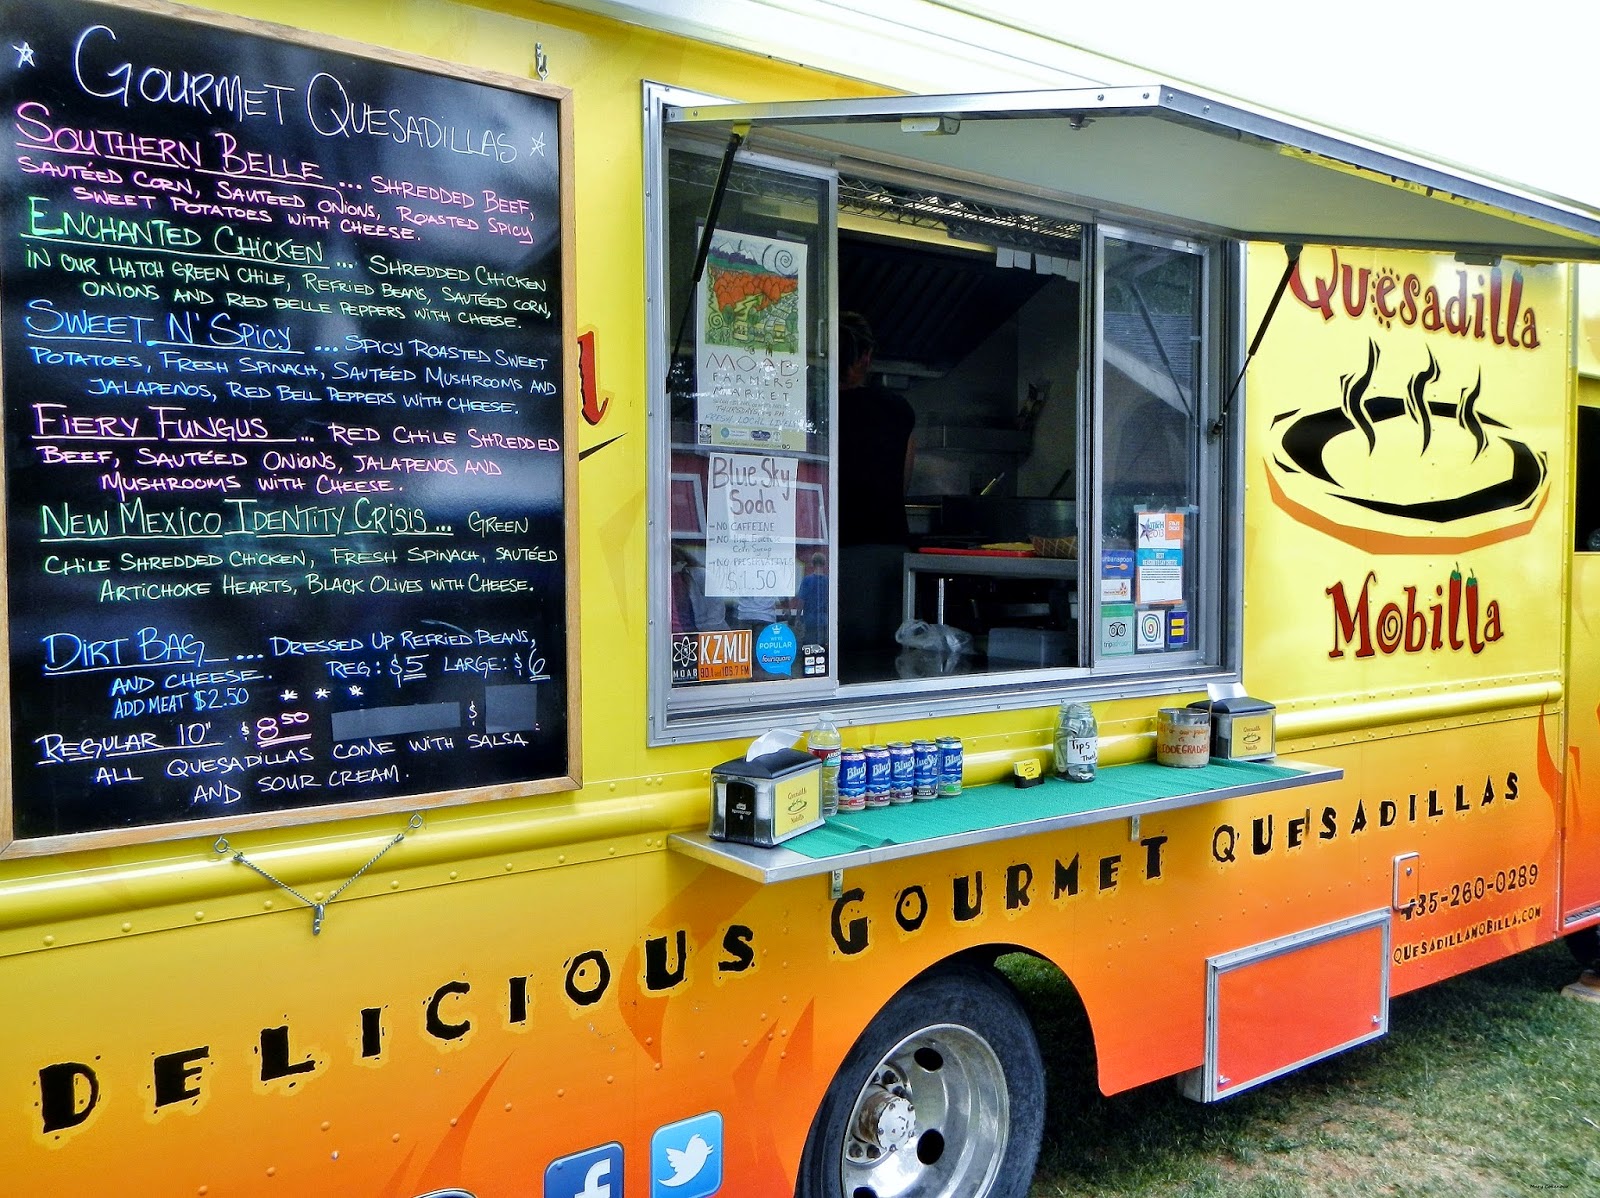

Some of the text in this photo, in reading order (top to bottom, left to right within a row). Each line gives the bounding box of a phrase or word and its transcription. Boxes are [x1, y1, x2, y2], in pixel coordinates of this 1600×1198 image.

[75, 25, 518, 163] GOURMET QUESADILLAS
[16, 102, 534, 221] SOUTHERN BELLE SHREDDED BEEF,
[73, 187, 421, 241] SWEET POTATOES WITH CHEESE.
[133, 171, 201, 199] CORN,
[318, 199, 381, 220] ONIONS,
[396, 205, 479, 231] ROASTED
[488, 217, 534, 244] SPICY
[28, 196, 546, 292] ENCHANTED CHICKEN SHREDDED CHICKEN
[25, 244, 51, 268] IN
[60, 254, 100, 276] OUR
[110, 256, 164, 279] HATCH
[171, 261, 230, 284] GREEN
[237, 266, 291, 293] CHILE,
[302, 272, 374, 296] REFRIED
[382, 283, 432, 305] BEANS,
[513, 299, 551, 319] CORN,
[1288, 248, 1542, 349] Quesadilla
[82, 281, 522, 329] ONIONS AND RED BELLE PEPPERS WITH CHEESE.
[26, 299, 154, 343] SWEET
[209, 313, 290, 351] SPICY
[345, 335, 403, 356] SPICY
[408, 339, 491, 363] ROASTED
[494, 350, 548, 370] SWEET
[30, 346, 152, 373] POTATOES,
[159, 351, 229, 373] FRESH
[239, 357, 325, 380] SPINACH,
[425, 366, 523, 391] MUSHROOMS
[529, 379, 556, 396] AND
[706, 353, 799, 376] MOAB
[88, 378, 519, 415] JALAPENOS, RED BELL PEPPERS WITH CHEESE.
[713, 386, 789, 401] MARKET
[32, 402, 560, 451] FIERY FUNGUS RED CHILE SHREDDED
[36, 445, 120, 468] BEEF,
[263, 450, 343, 475] ONIONS,
[353, 455, 458, 475] JALAPENOS
[464, 460, 502, 475] AND
[712, 457, 790, 500] Blue Sky
[101, 471, 403, 502] MUSHROOMS WITH CHEESE.
[729, 489, 776, 515] Soda
[41, 502, 109, 536] NEW
[119, 497, 222, 536] MEXICO
[224, 498, 345, 535] IDENTITY
[468, 511, 529, 537] GREEN
[730, 522, 775, 532] CAFFEINE
[44, 555, 111, 575] CHILE
[120, 553, 223, 572] SHREDDED
[229, 550, 315, 569] CHICKEN,
[331, 547, 398, 565] FRESH
[407, 547, 486, 564] SPINACH,
[751, 544, 772, 557] Syrup
[100, 573, 534, 602] ARTICHOKE HEARTS, BLACK OLIVES WITH CHEESE.
[1325, 562, 1504, 658] Mobilla
[42, 626, 536, 671] DIRT BAG DRESSED UP REFRIED BEANS,
[700, 633, 749, 665] KZMU
[759, 641, 793, 650] POPULAR
[761, 654, 791, 665] foursquare
[111, 669, 273, 697] AND CHEESE.
[326, 659, 381, 679] REG:
[673, 668, 698, 678] MOAB
[700, 668, 714, 678] 90.1
[740, 665, 749, 675] FM
[114, 687, 249, 719] ADD MEAT $2.50
[34, 733, 164, 763] REGULAR
[96, 733, 529, 785] ALL QUESADILLAS COME WITH SALSA
[1069, 738, 1091, 755] Tips
[194, 765, 410, 804] AND SOUR CREAM.
[38, 772, 1519, 1134] DELICIOUS GOURMET QUESADILLAS
[1393, 906, 1542, 964] QUESADILLAMOBILLA.COM
